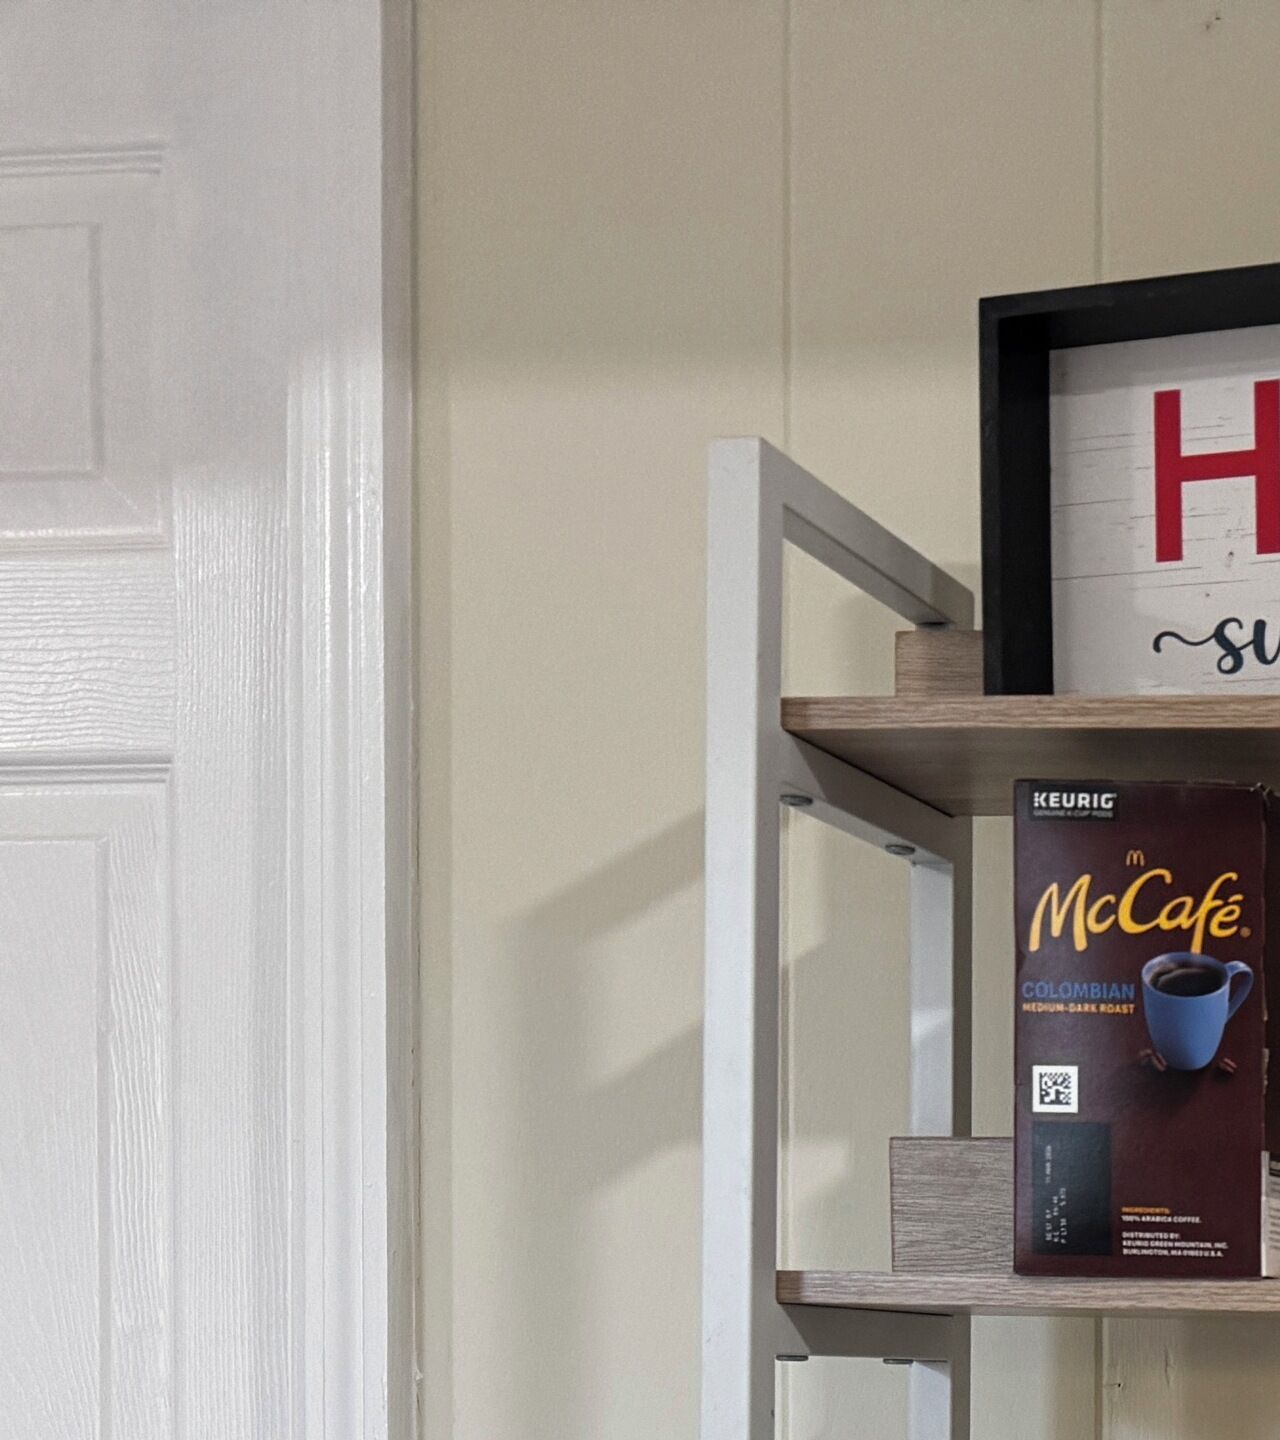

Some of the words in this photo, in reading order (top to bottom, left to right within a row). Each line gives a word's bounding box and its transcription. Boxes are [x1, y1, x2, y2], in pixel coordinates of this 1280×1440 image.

[1033, 791, 1114, 809] KEURIG
[1022, 981, 1135, 999] COLOMBIAN
[1022, 1002, 1097, 1013] MEDIUM-DARK
[1099, 1003, 1135, 1014] ROAST
